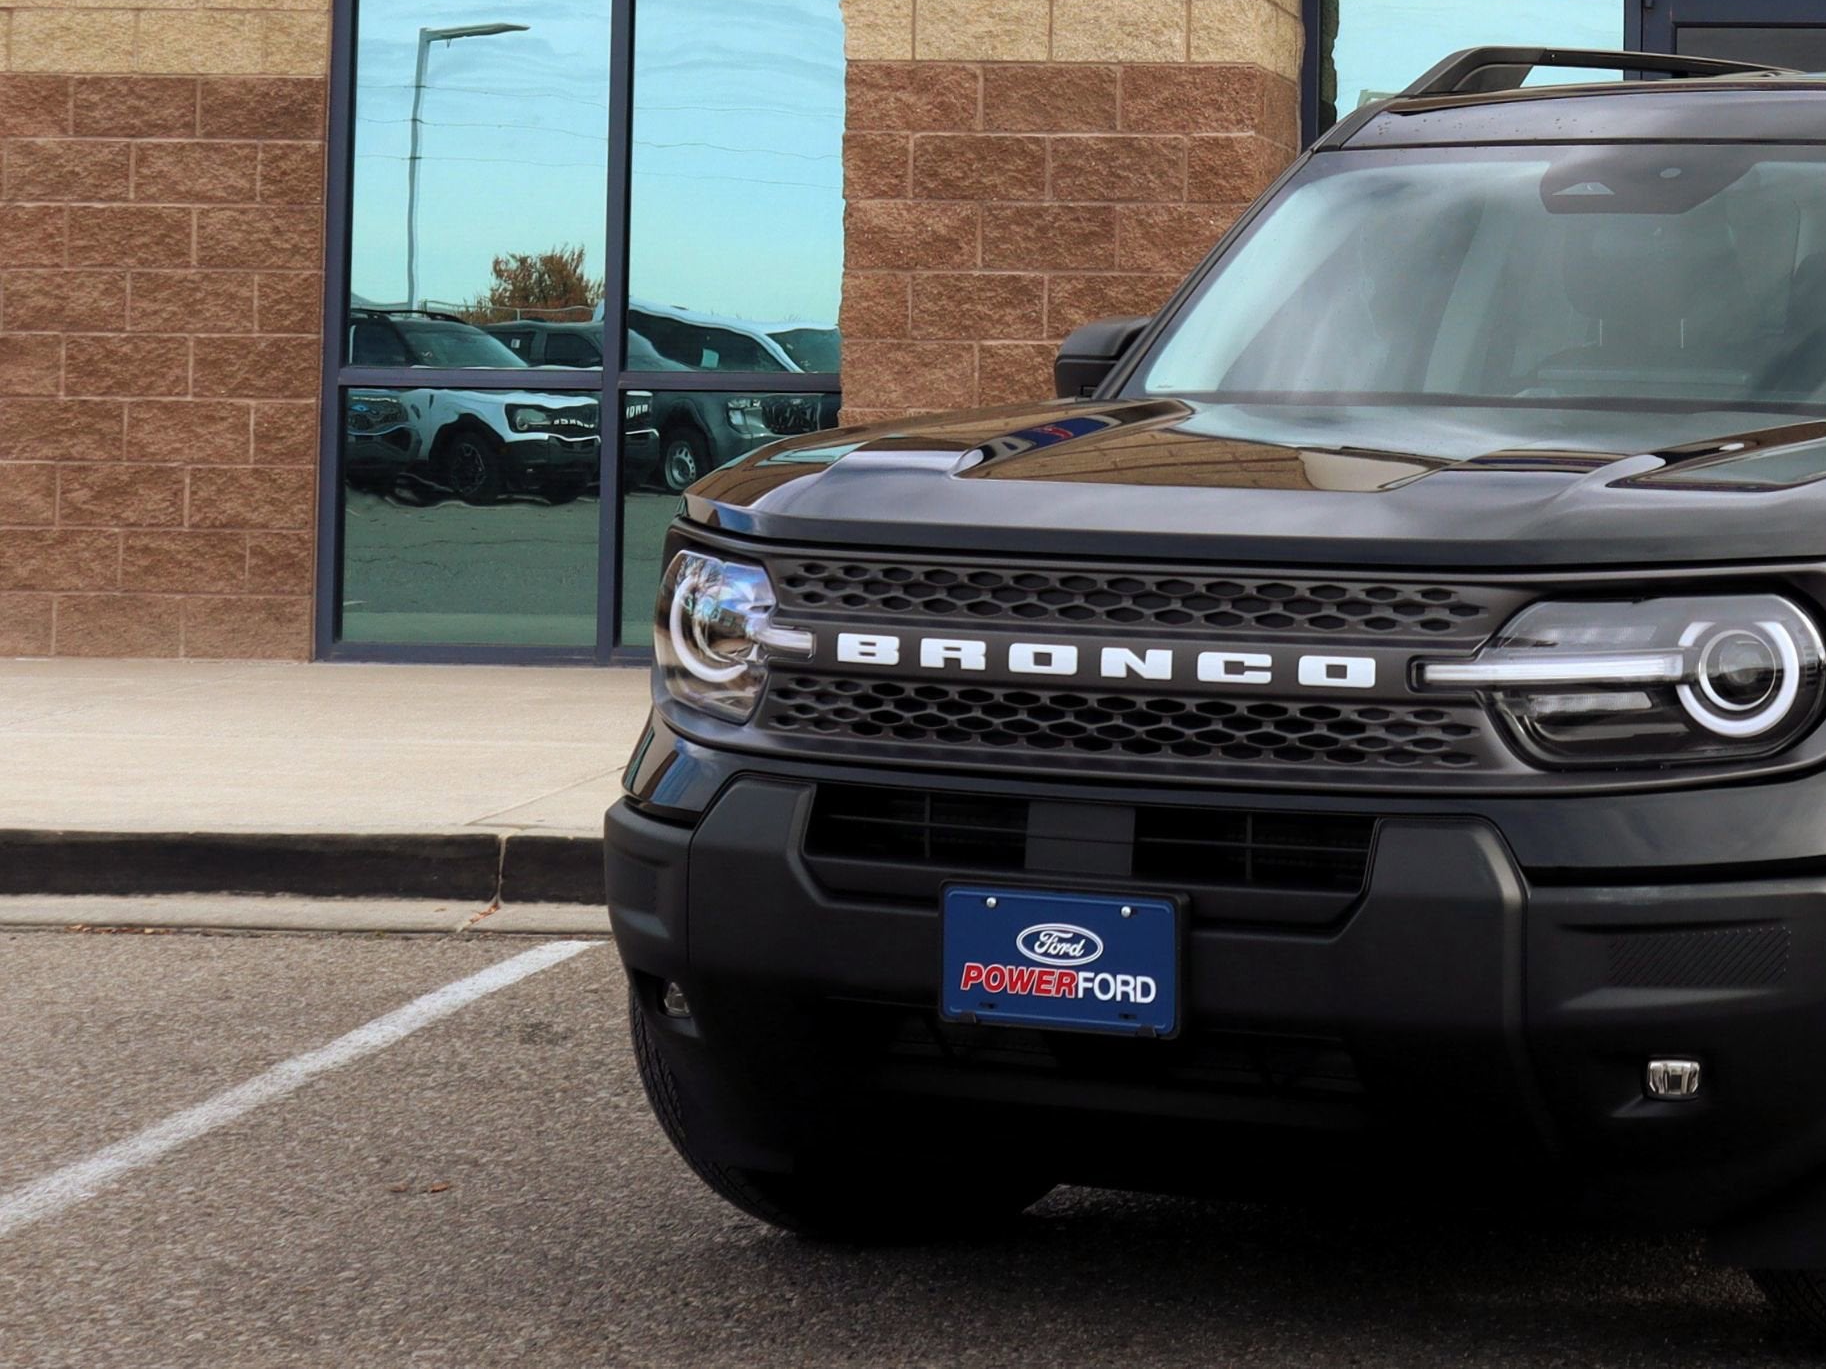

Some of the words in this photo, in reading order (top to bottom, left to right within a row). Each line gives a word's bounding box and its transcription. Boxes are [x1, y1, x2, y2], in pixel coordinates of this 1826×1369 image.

[836, 632, 1377, 689] BRONCO
[1033, 930, 1086, 958] Ford
[960, 962, 1157, 1004] POWERFORD
